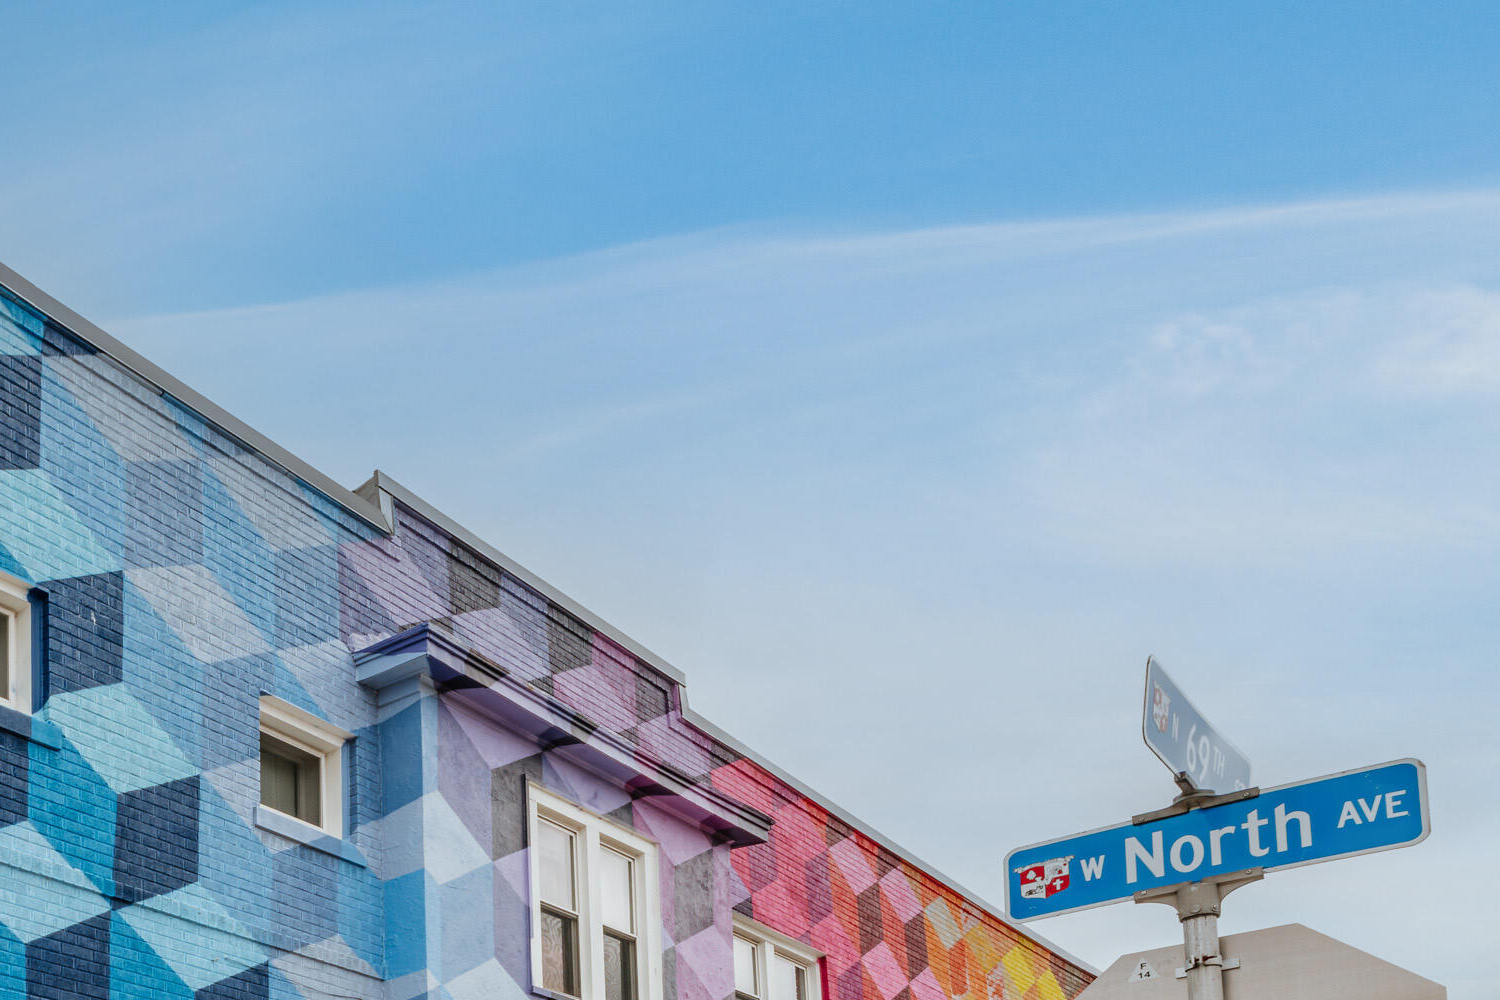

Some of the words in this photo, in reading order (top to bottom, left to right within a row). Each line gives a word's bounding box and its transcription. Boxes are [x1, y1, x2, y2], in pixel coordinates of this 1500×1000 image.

[1172, 712, 1179, 742] N
[1080, 855, 1105, 882] W
[1124, 803, 1312, 884] North
[1337, 789, 1409, 829] AVE
